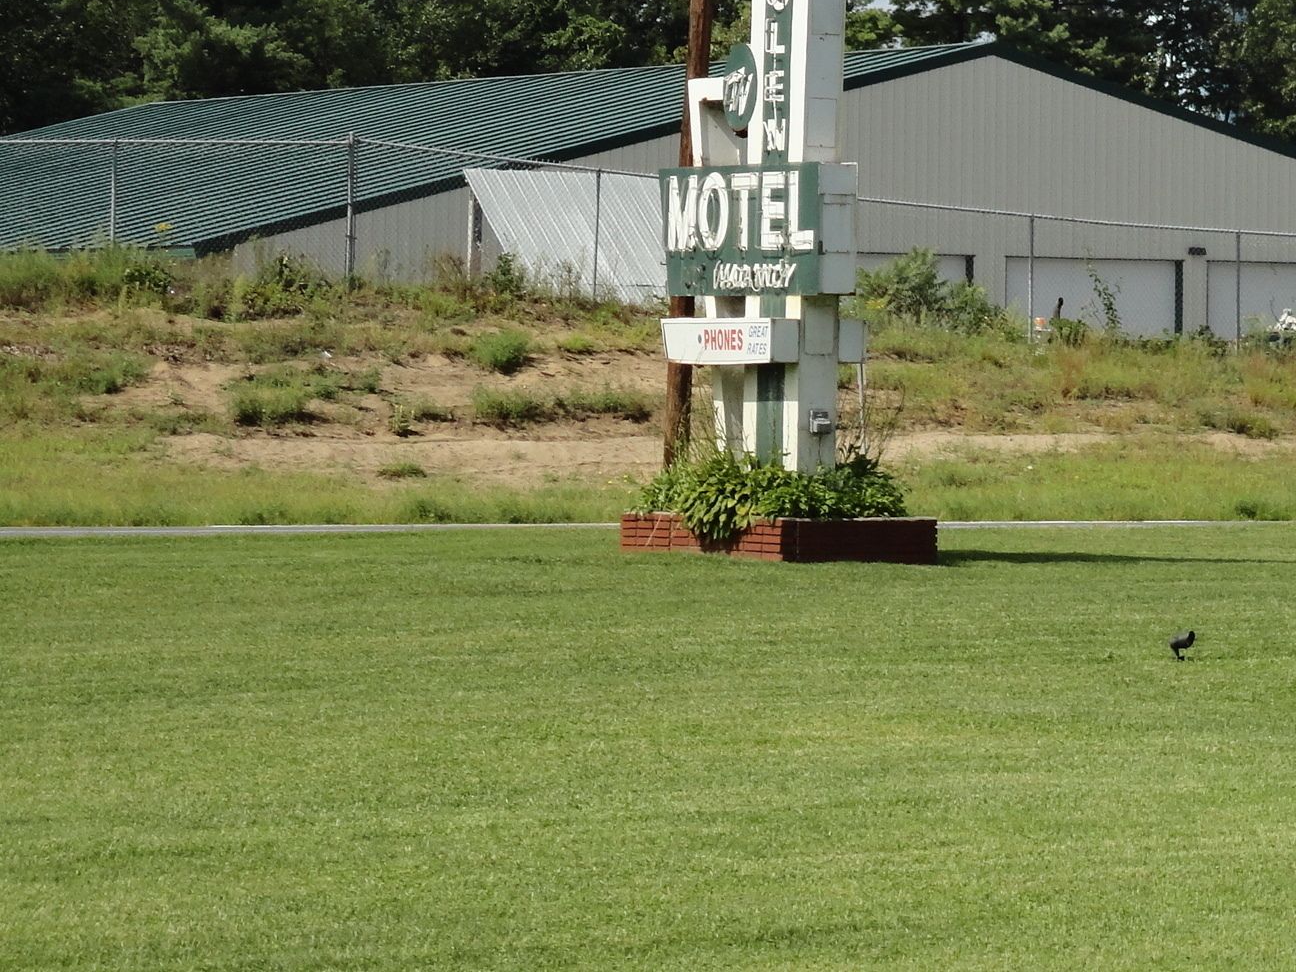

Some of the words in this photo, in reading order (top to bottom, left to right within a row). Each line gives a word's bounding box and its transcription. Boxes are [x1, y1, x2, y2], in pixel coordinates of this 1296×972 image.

[666, 170, 815, 253] MOTEL
[713, 258, 797, 291] VACANCY
[703, 329, 744, 351] PHONES
[748, 325, 769, 338] GREAT
[747, 342, 768, 355] RATES
